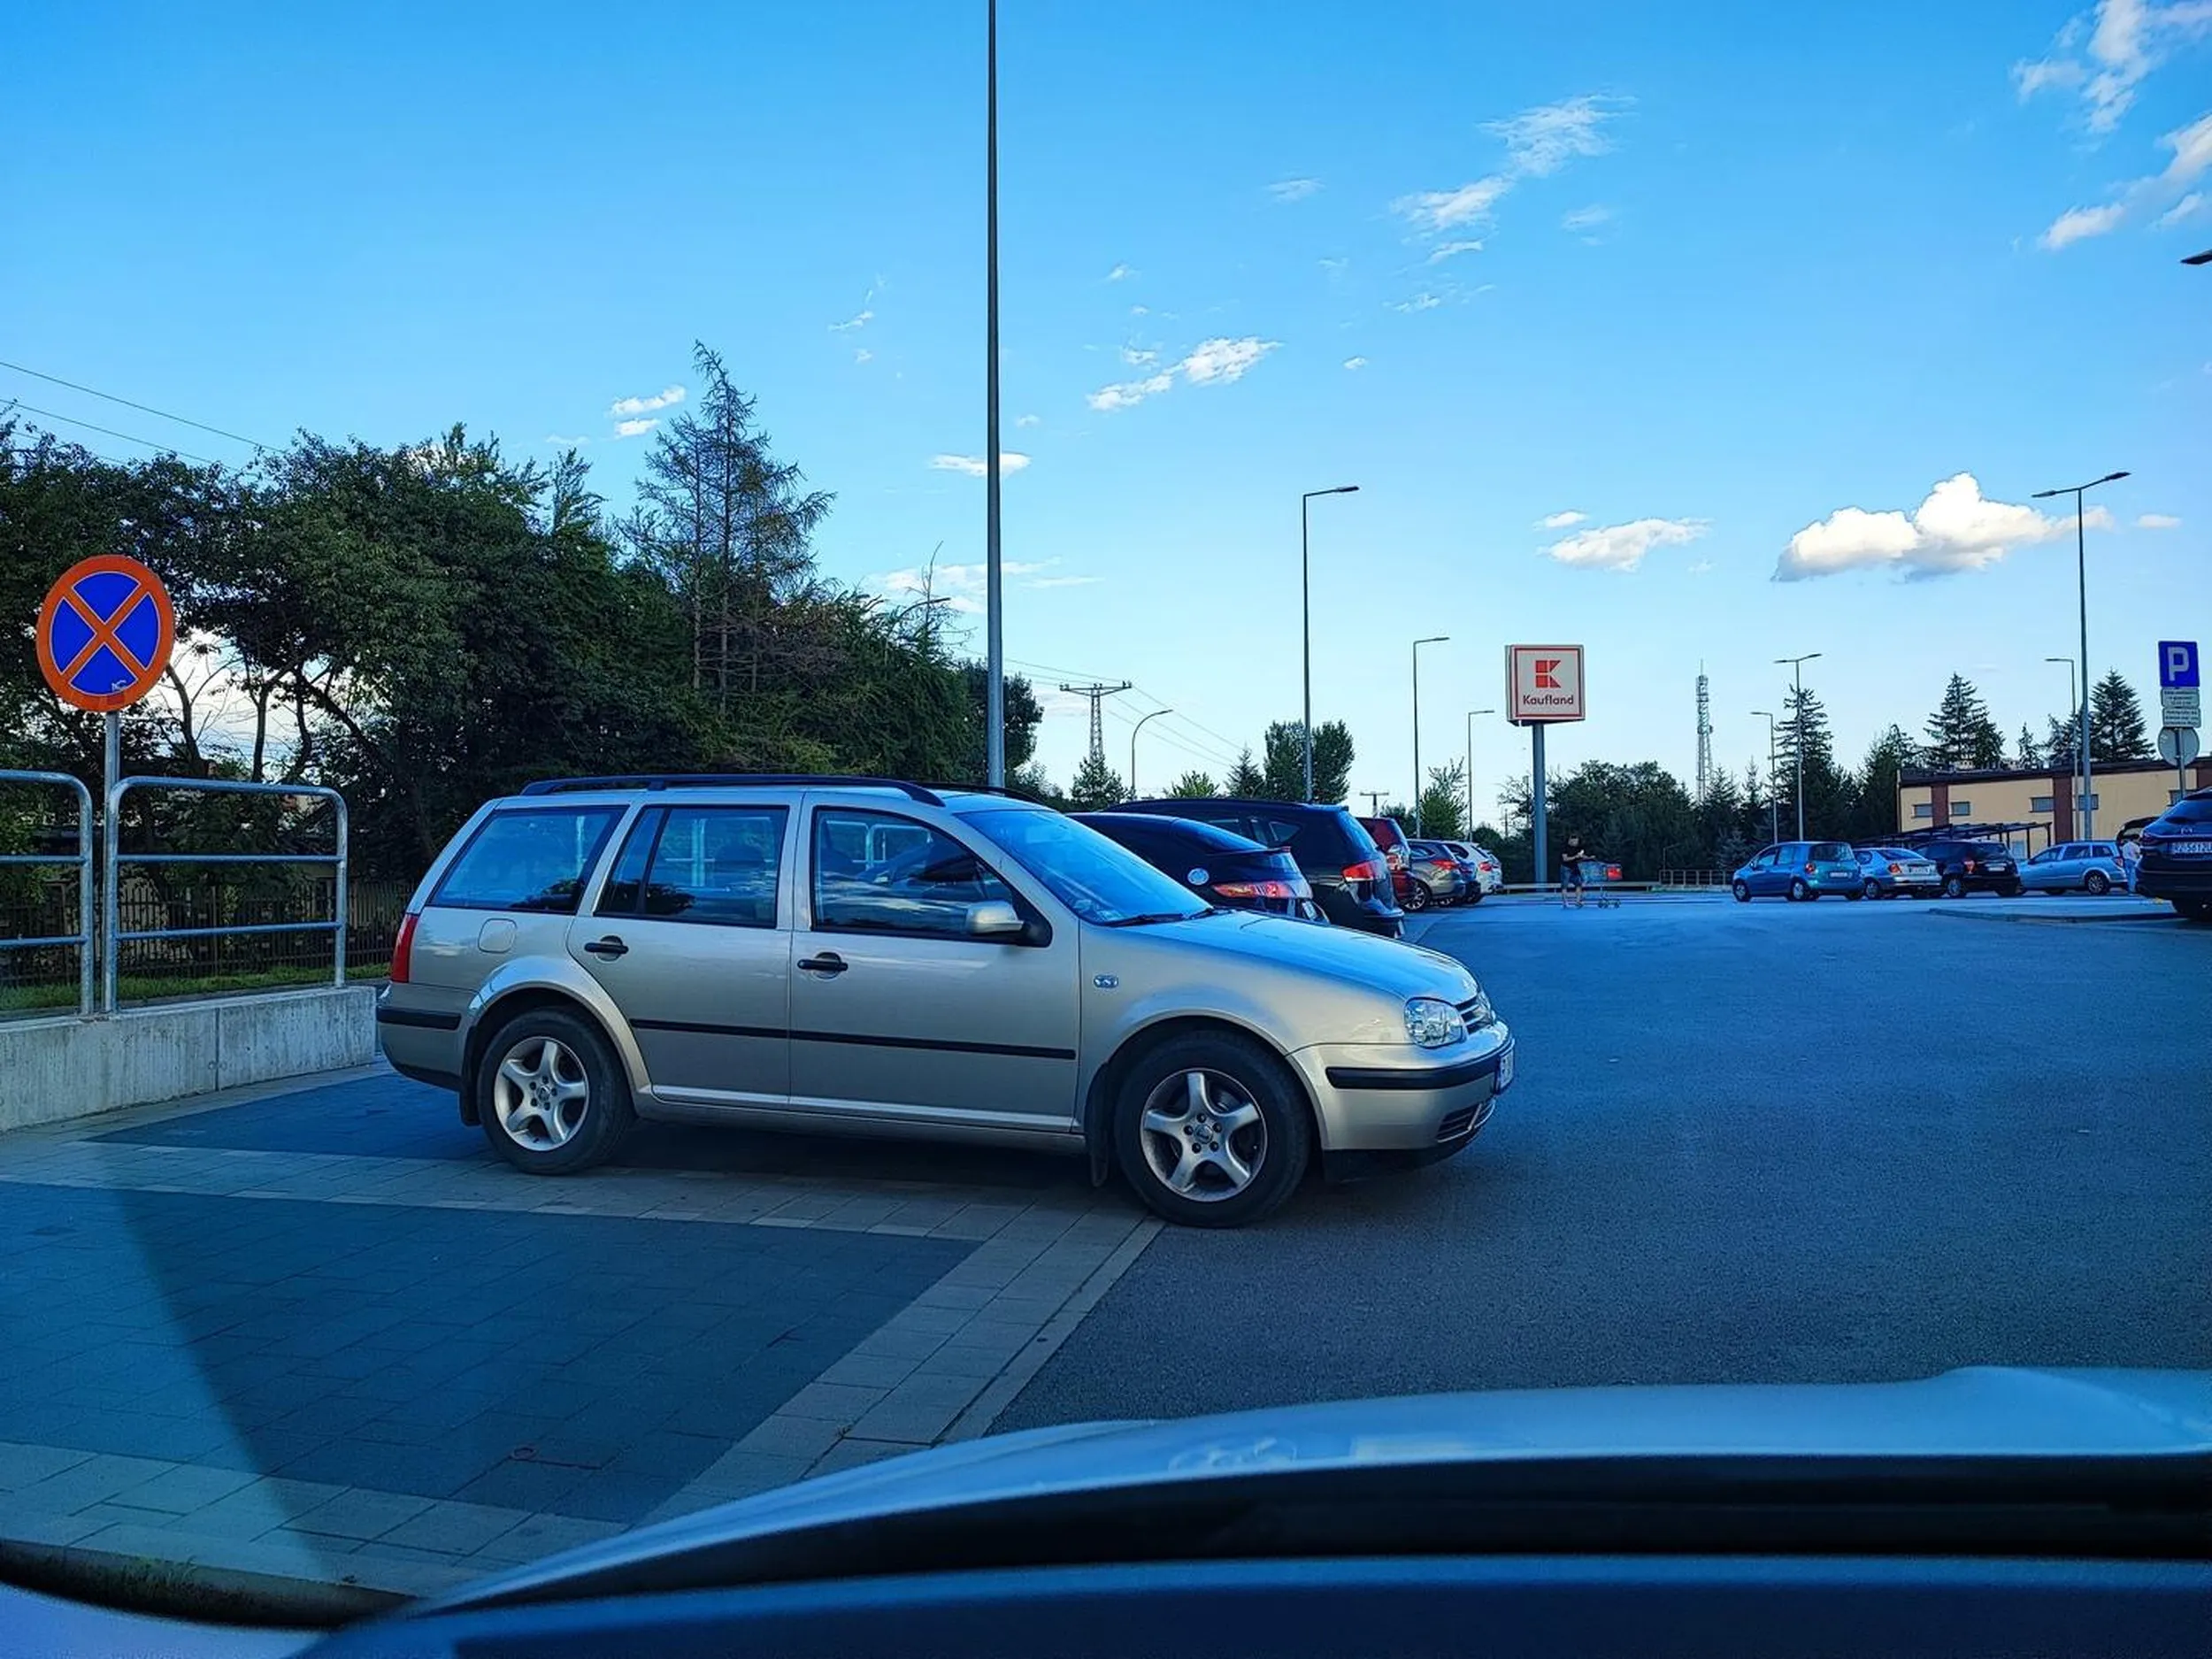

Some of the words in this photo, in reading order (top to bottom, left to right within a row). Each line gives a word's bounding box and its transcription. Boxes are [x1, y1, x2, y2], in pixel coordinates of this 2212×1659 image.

[1535, 659, 1562, 688] K
[2167, 647, 2190, 681] P
[1523, 694, 1574, 705] Kaufland
